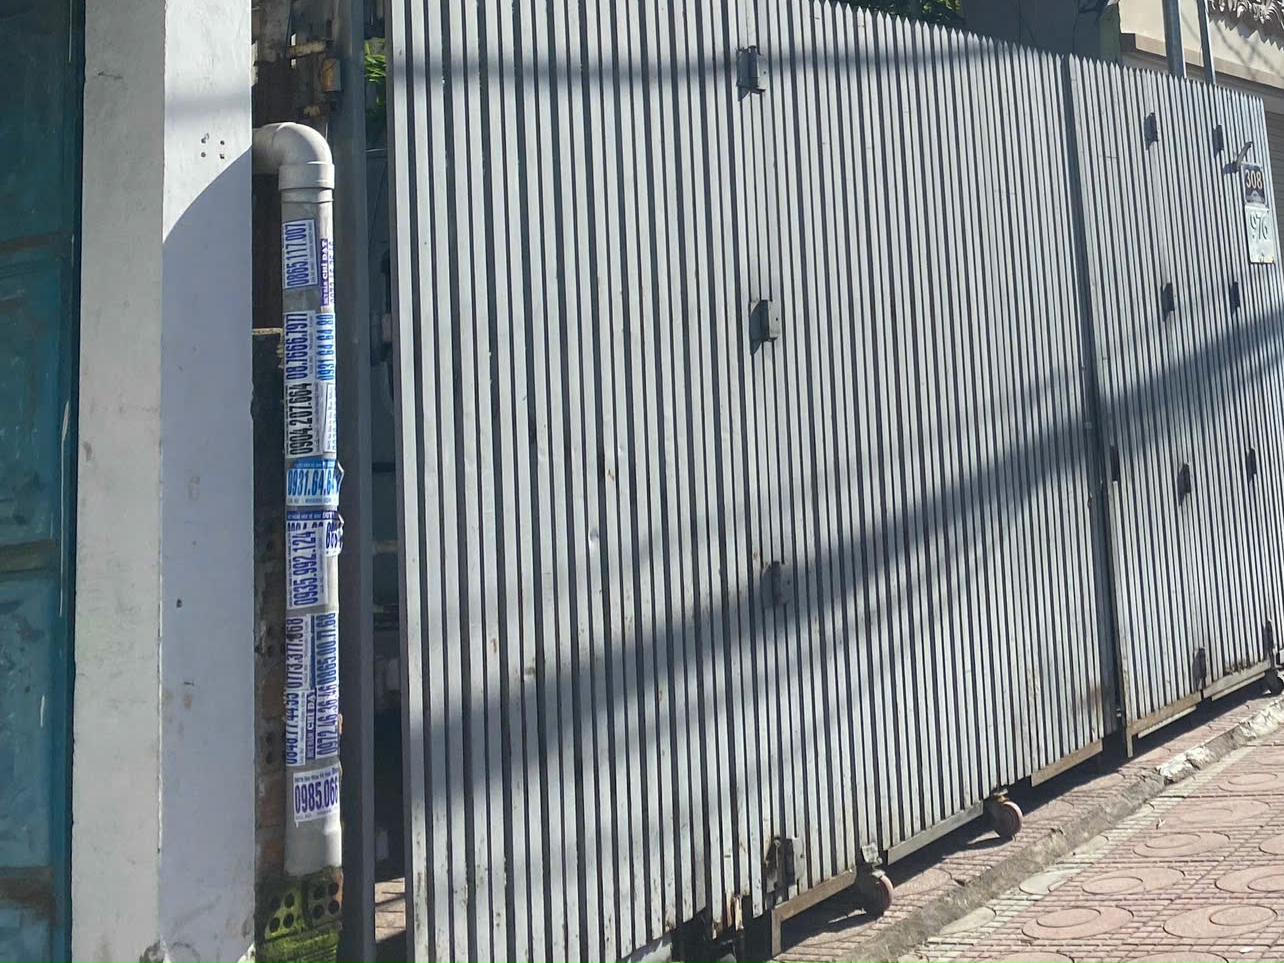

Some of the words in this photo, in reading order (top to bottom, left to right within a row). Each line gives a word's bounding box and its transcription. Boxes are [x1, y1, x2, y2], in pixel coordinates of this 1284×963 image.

[1245, 169, 1263, 190] 308
[285, 223, 309, 286] 0865.117.007
[288, 382, 314, 456] 0904.207.664
[292, 531, 319, 606] 0935.992.124
